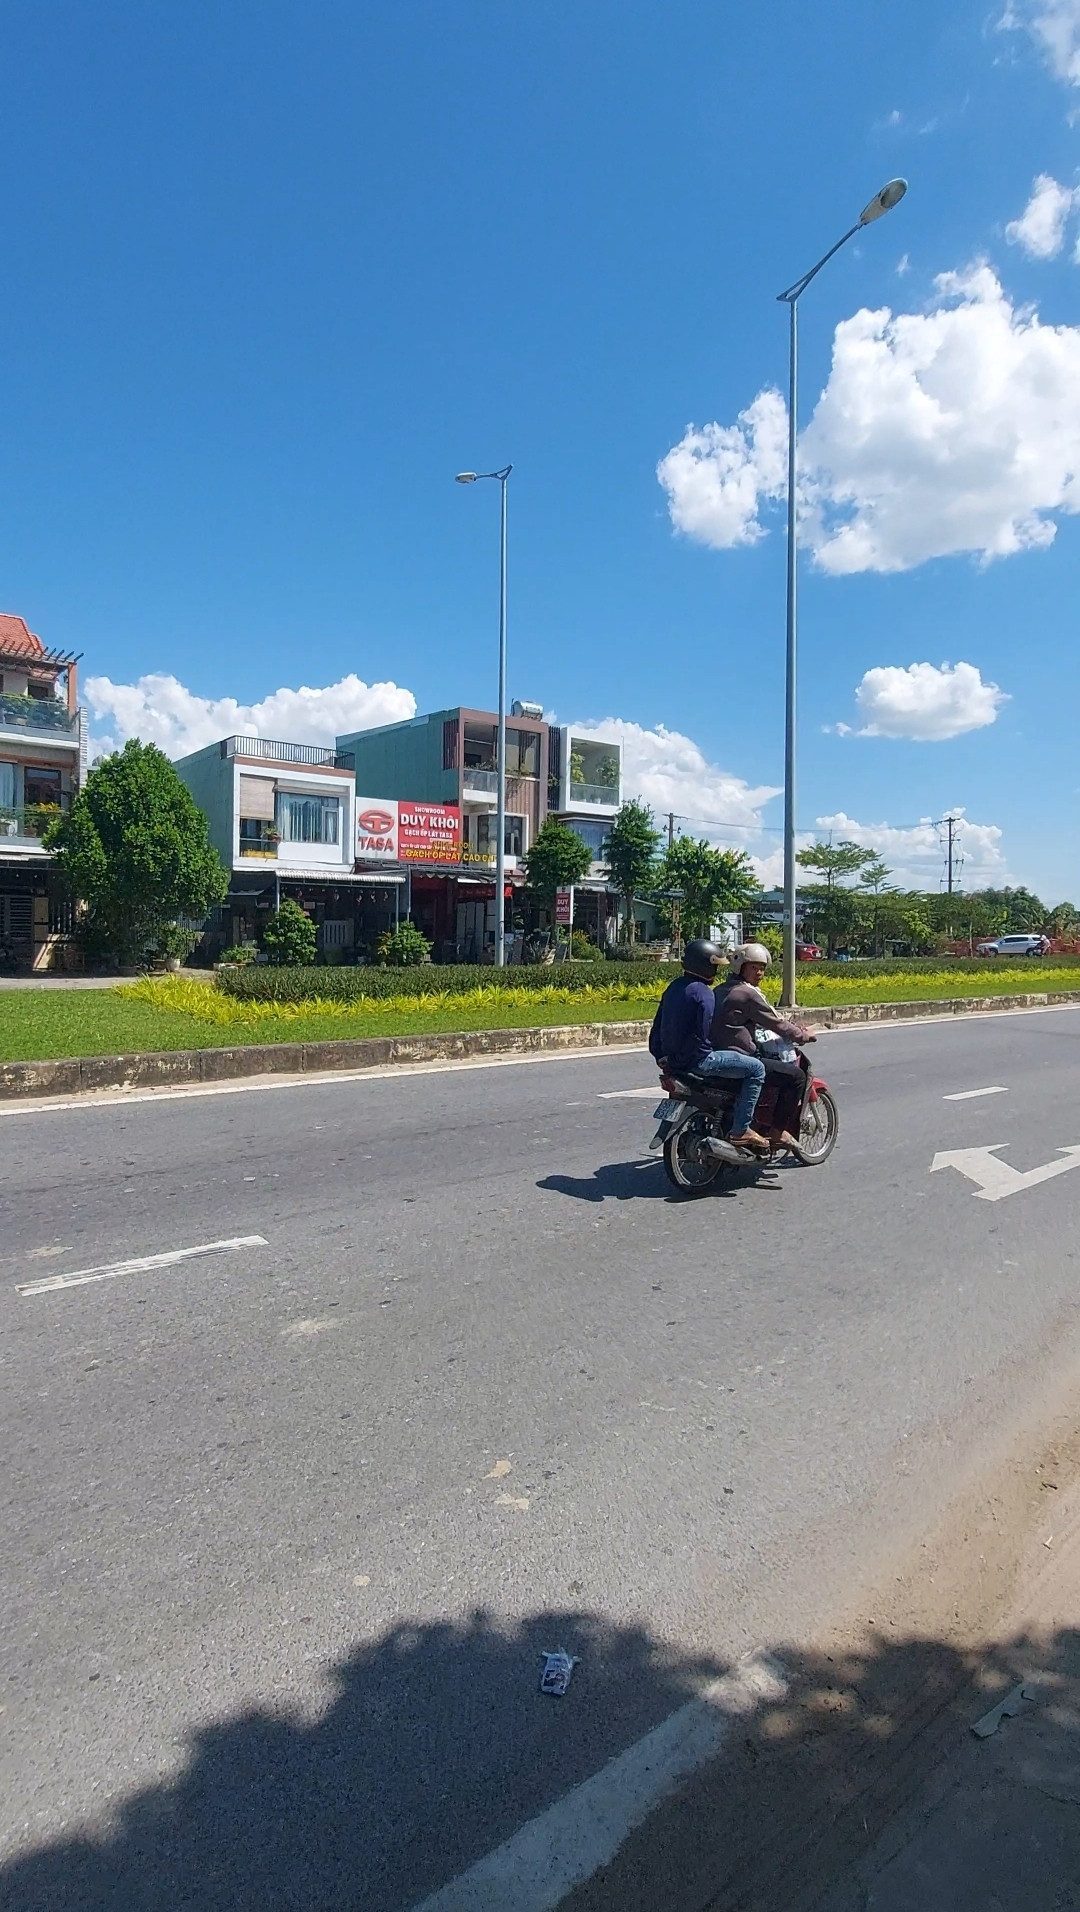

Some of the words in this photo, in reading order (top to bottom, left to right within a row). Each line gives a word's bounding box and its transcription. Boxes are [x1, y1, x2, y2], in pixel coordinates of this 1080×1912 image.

[414, 806, 445, 815] SHOWROOM
[400, 813, 427, 827] DUY
[429, 815, 459, 830] KHÔI
[358, 836, 395, 852] TASA
[463, 853, 481, 862] CAO
